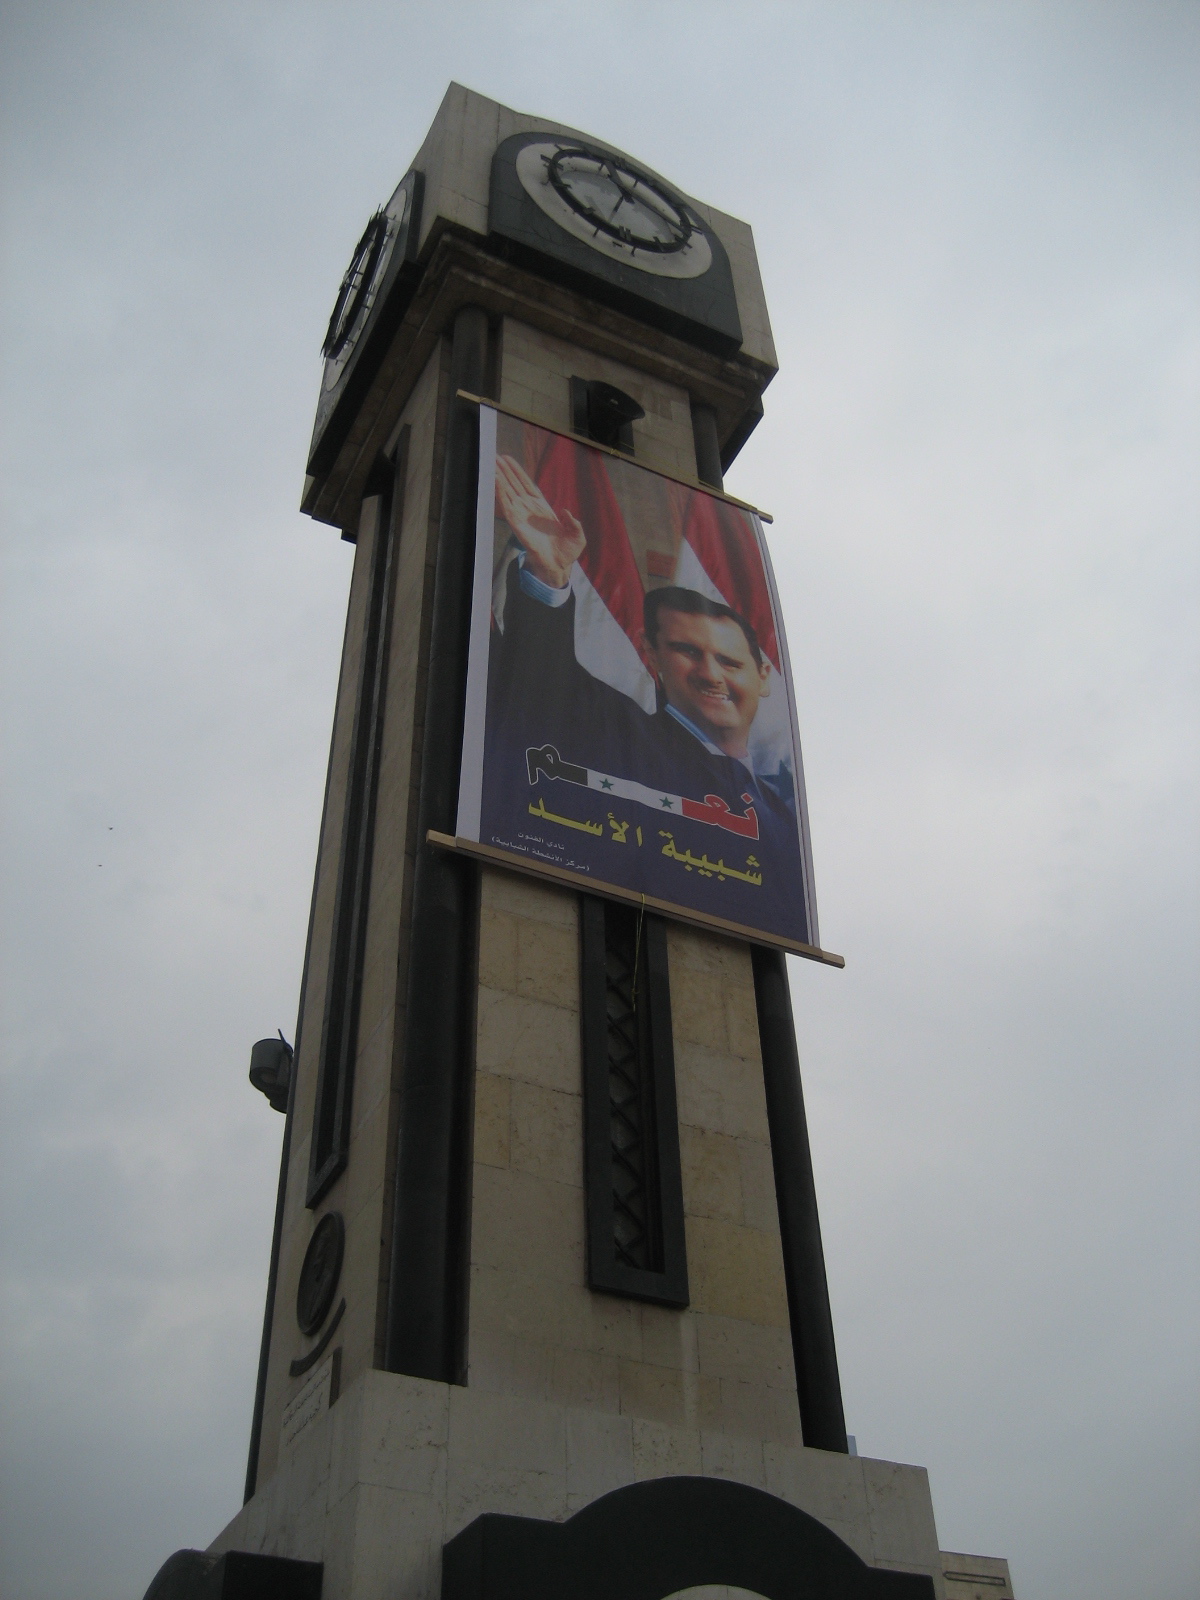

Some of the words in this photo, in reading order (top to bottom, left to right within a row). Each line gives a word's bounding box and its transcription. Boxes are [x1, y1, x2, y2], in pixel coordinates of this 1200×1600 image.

[528, 797, 644, 848] الأسد
[546, 841, 565, 851] نادي
[658, 829, 763, 886] شبيبة
